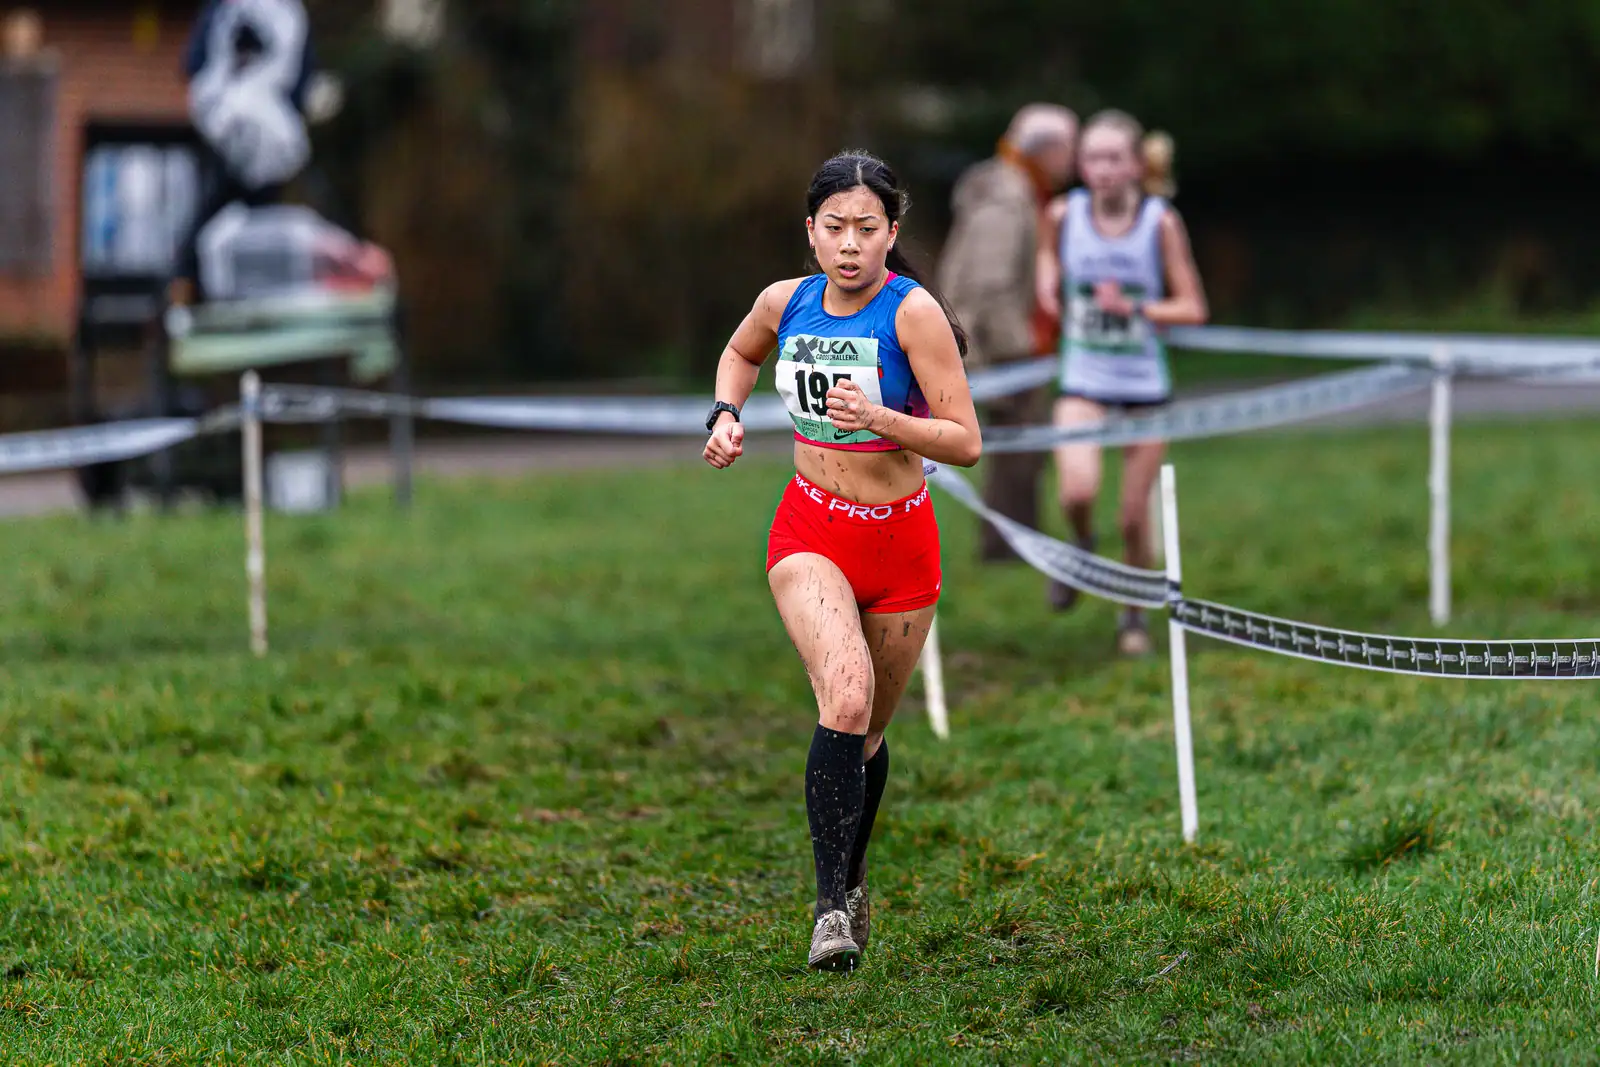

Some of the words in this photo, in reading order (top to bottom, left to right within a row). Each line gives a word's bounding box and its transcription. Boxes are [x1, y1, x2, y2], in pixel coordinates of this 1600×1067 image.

[818, 340, 858, 354] UKA
[795, 369, 851, 416] 19
[828, 497, 892, 520] PRO
